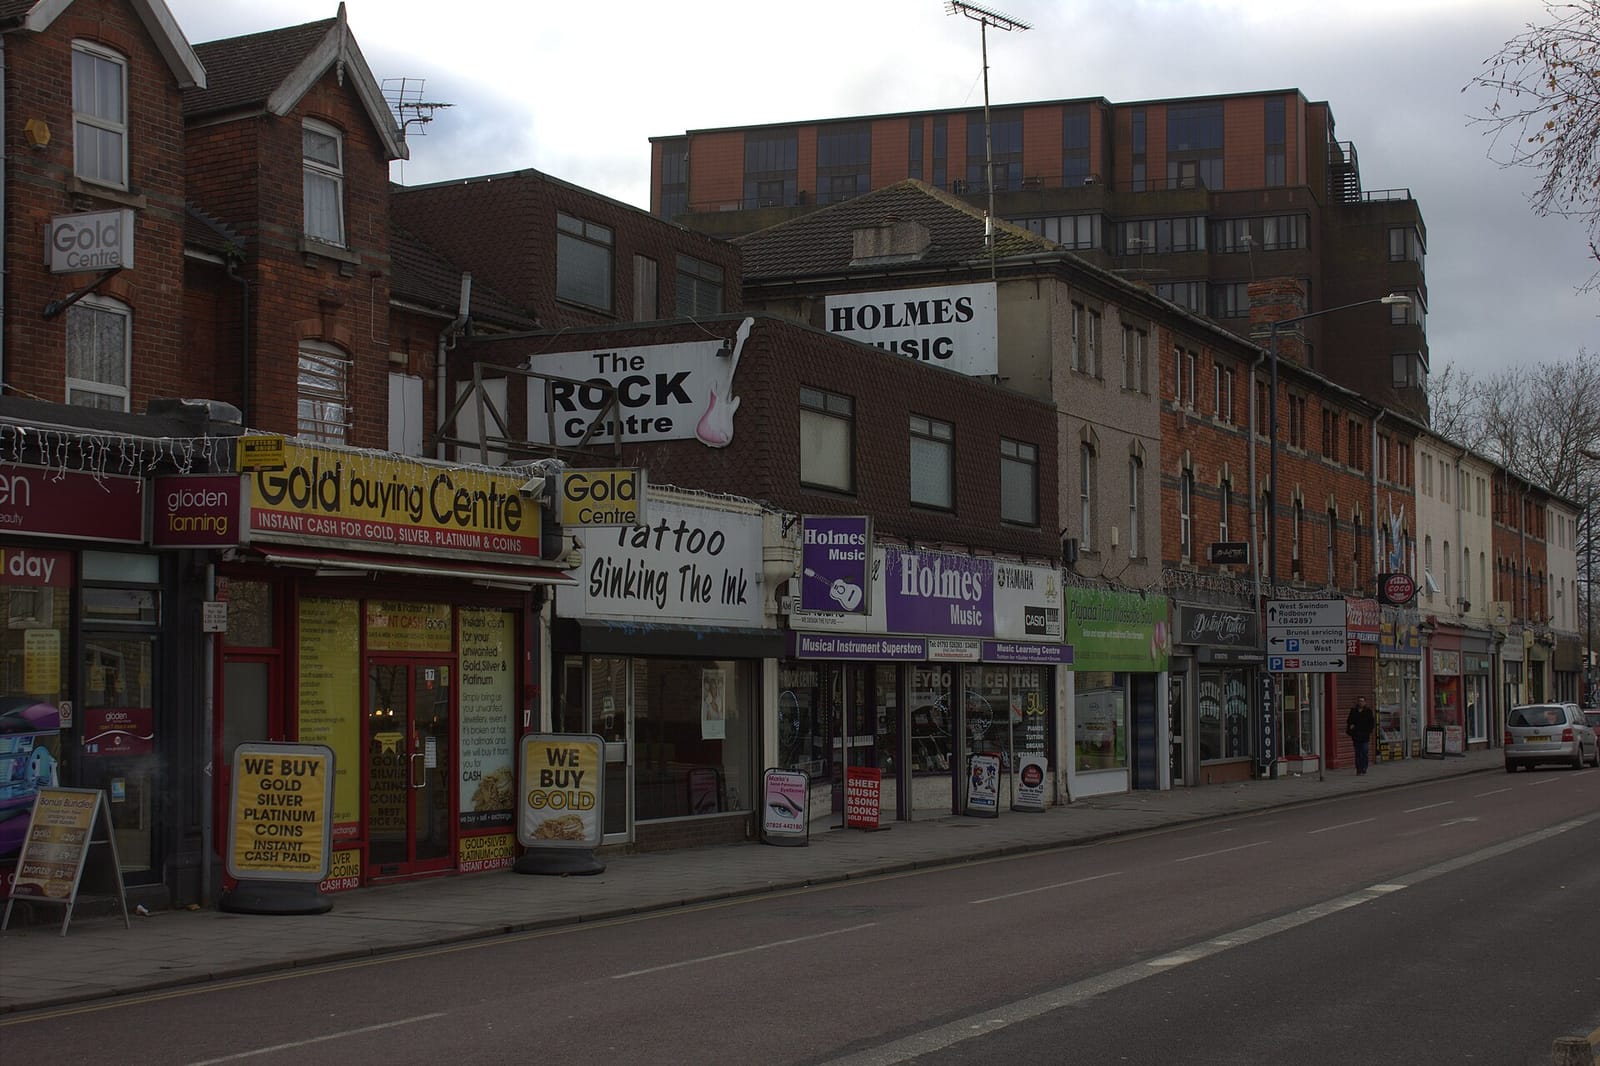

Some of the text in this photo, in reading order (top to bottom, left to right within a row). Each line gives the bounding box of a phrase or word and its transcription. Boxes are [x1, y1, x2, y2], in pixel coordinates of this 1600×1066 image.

[53, 219, 120, 251] Gold
[67, 250, 120, 268] Centre
[830, 297, 974, 332] HOLMES
[594, 353, 645, 373] The
[545, 371, 692, 412] ROCK
[564, 474, 636, 500] Gold
[258, 457, 522, 532] Gold buying Centre
[0, 512, 24, 525] eauty
[578, 508, 636, 524] Centre
[167, 513, 228, 535] Tanning
[258, 512, 303, 530] INSTANT
[307, 517, 337, 534] CASH
[340, 521, 361, 537] FOR
[435, 532, 481, 549] PLATINUM
[483, 537, 490, 549] &
[492, 537, 522, 552] COINS
[618, 518, 726, 555] Tattoo
[804, 529, 866, 545] Holmes
[829, 549, 866, 560] Music
[9, 551, 56, 582] day
[589, 556, 747, 609] Sinking The Ink
[900, 553, 983, 602] Holmes
[1006, 568, 1034, 590] YAMAHA
[1299, 602, 1328, 610] Swindon
[951, 604, 983, 626] Music
[1025, 615, 1045, 627] CASIO
[463, 631, 472, 642] for
[474, 632, 489, 645] your
[1312, 629, 1342, 638] servicing
[463, 647, 497, 657] unwanted
[802, 638, 834, 652] Musical
[837, 639, 881, 654] Instrument
[882, 643, 922, 656] Superstore
[997, 643, 1060, 656] Music Learning Centre
[463, 674, 493, 685] Platinum
[985, 673, 1039, 688] CENTRE
[1263, 679, 1272, 758] TATTOOS
[546, 748, 579, 767] WE
[244, 758, 320, 777] WE BUY
[463, 771, 482, 781] CASH
[540, 769, 584, 788] BUY
[259, 778, 302, 791] GOLD
[848, 779, 879, 788] SHEET
[528, 789, 596, 811] GOLD
[848, 788, 879, 798] MUSIC
[40, 797, 61, 807] Bonus
[257, 794, 303, 807] SILVER
[854, 797, 879, 807] SONG
[243, 808, 316, 822] PLATINUM
[848, 806, 878, 816] BOOKS
[369, 817, 392, 826] RICE
[255, 823, 303, 837] COINS
[253, 840, 303, 851] INSTANT
[465, 836, 508, 849] GOLD SILVER
[244, 850, 312, 863] CASH PAID
[333, 853, 351, 865] LVER
[459, 849, 491, 861] PLATINUM
[333, 864, 359, 878] COINS
[484, 859, 499, 871] CASH
[320, 877, 359, 891] CASH PAID
